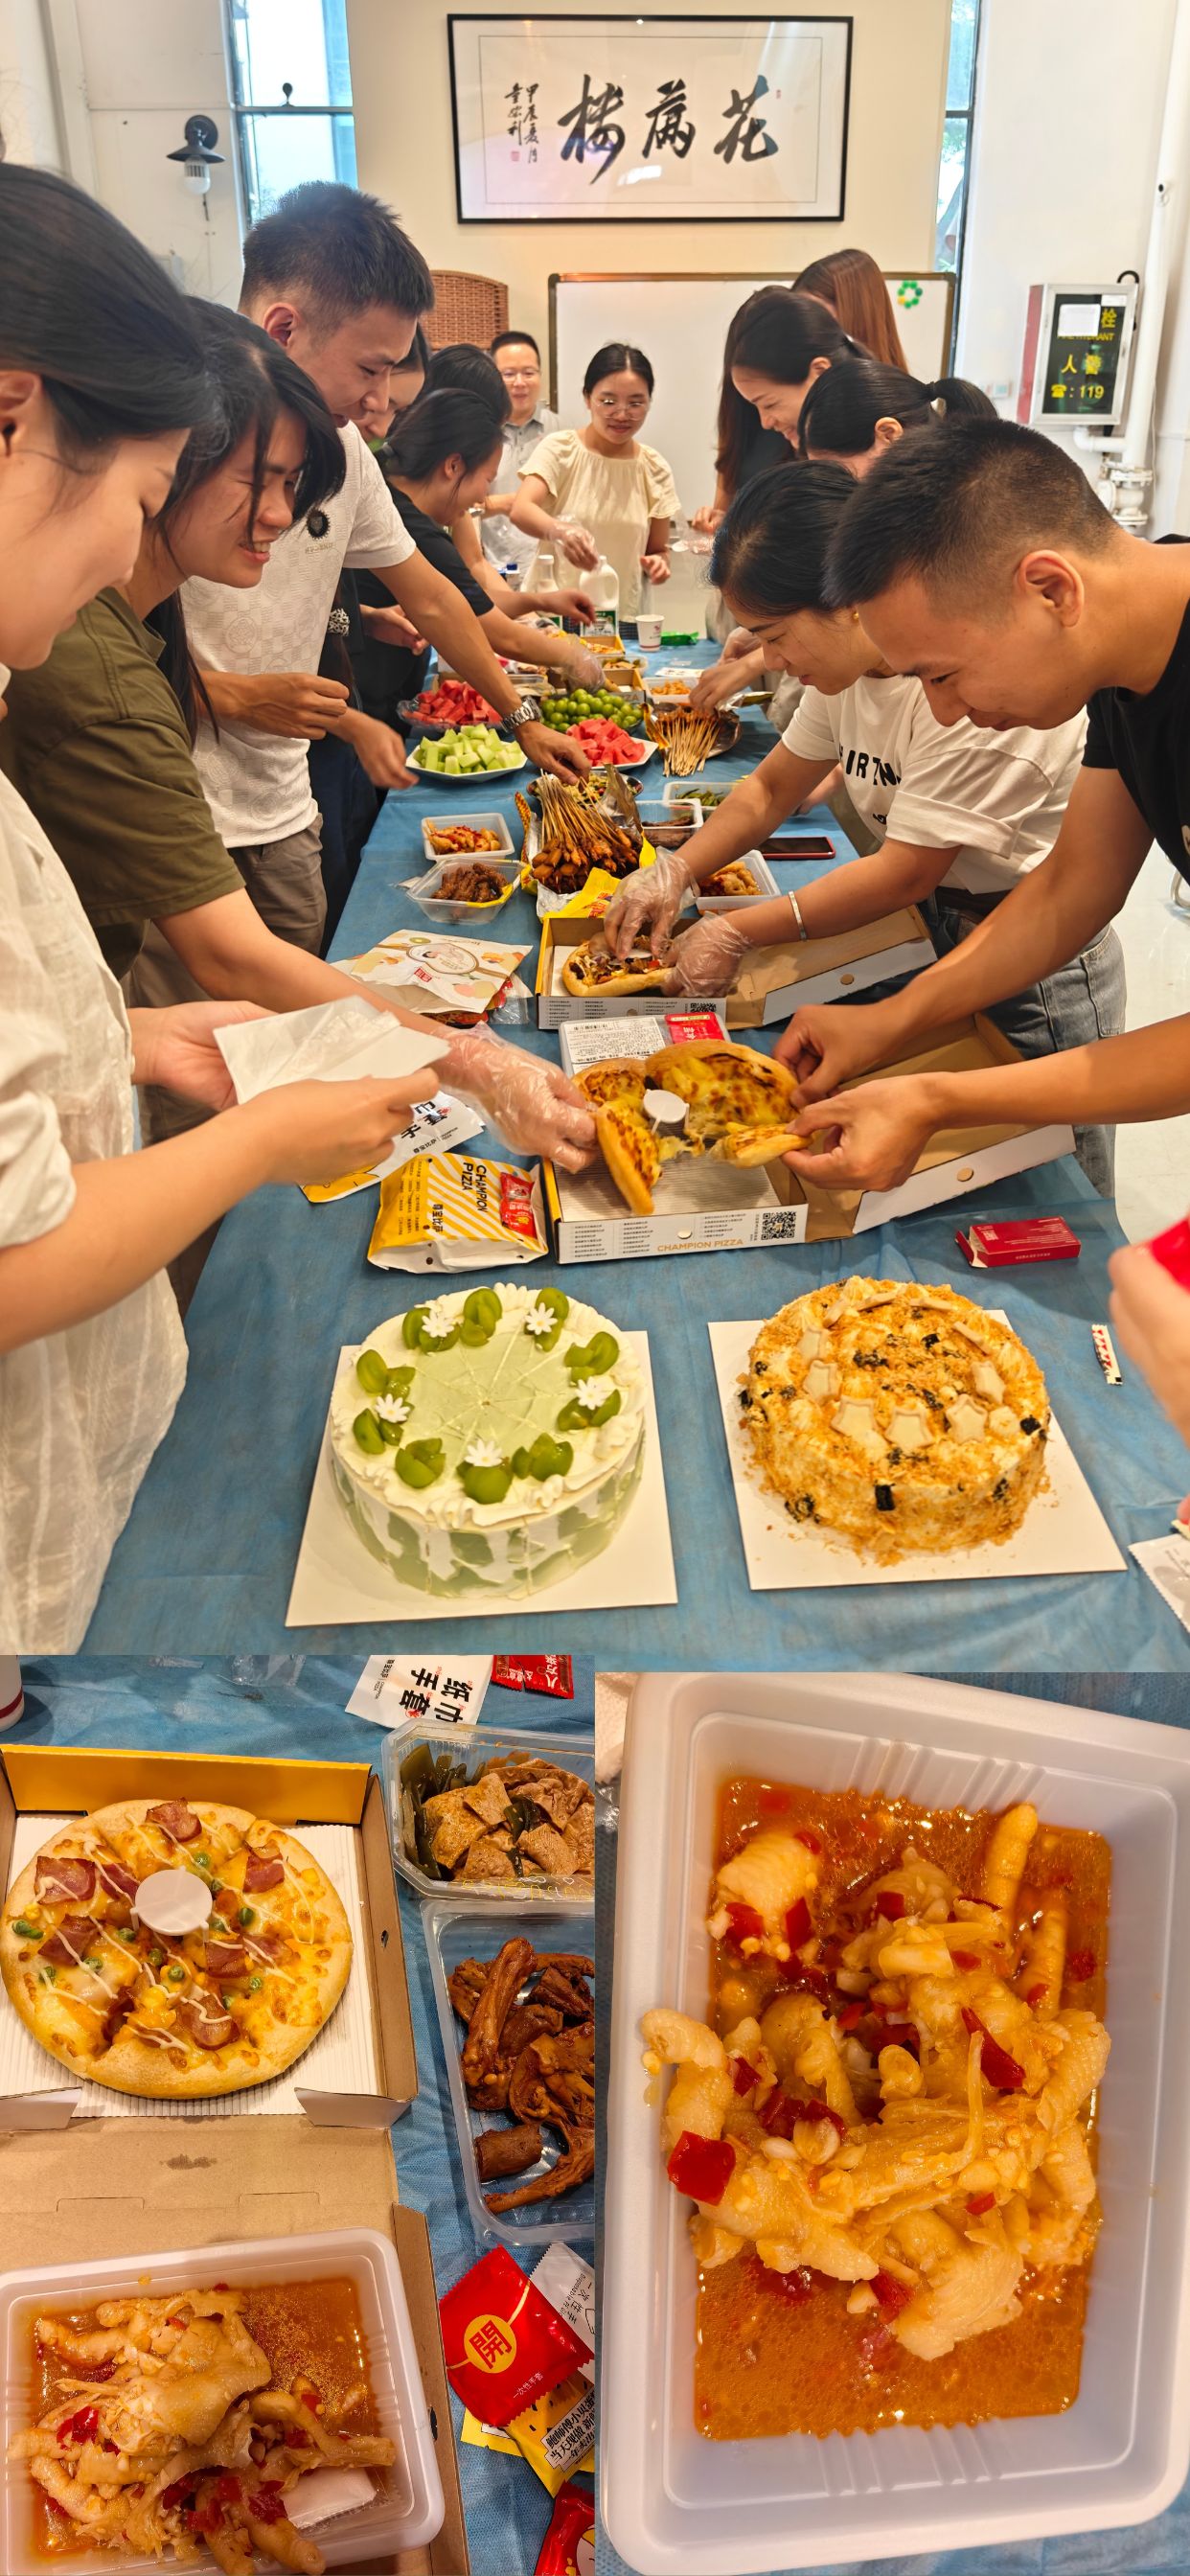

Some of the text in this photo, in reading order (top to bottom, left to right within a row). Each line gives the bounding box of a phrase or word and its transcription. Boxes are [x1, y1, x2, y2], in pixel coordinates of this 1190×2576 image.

[461, 1162, 473, 1190] PIZZA
[476, 1165, 489, 1213] CHAMPION
[657, 1238, 744, 1252] CHAMPION PIZZA
[399, 1668, 439, 1715] 手套
[434, 1677, 473, 1722] 纸巾
[469, 2319, 513, 2369] 開
[514, 2372, 544, 2399] 一次性手套
[550, 2425, 586, 2462] 当天现做
